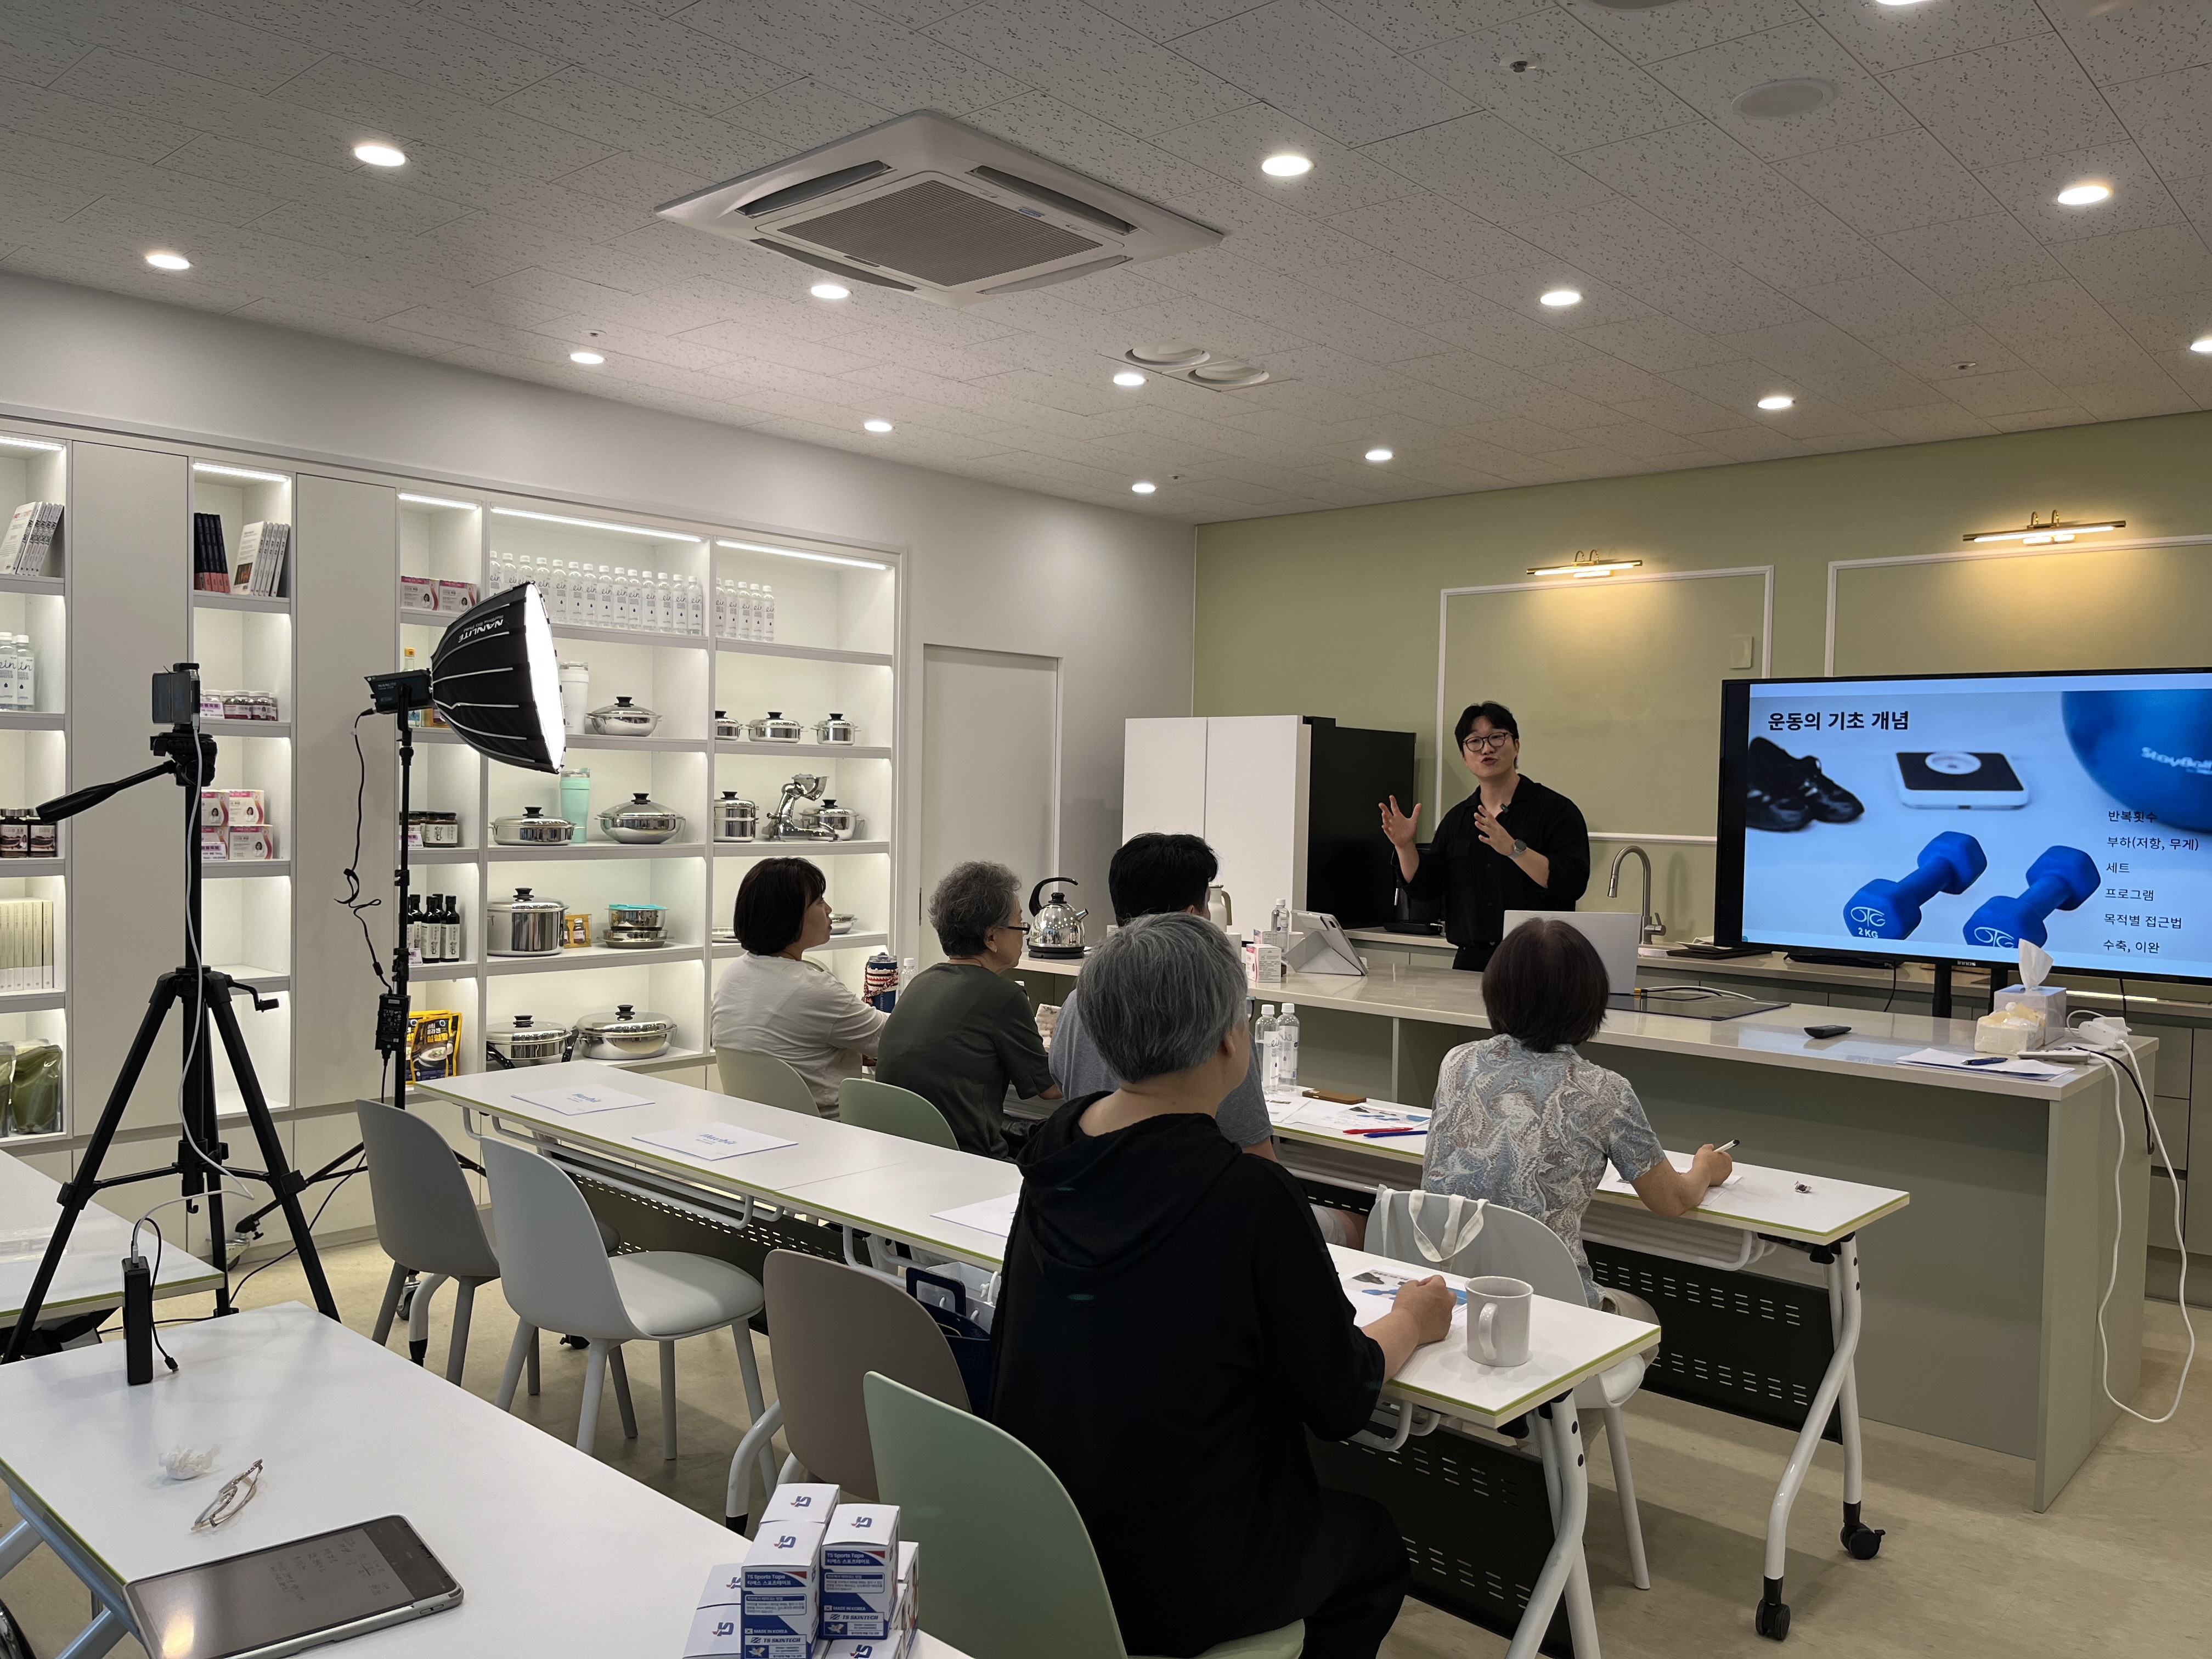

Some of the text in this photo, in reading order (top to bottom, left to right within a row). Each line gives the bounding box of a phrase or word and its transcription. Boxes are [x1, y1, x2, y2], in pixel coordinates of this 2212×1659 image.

[458, 619, 504, 644] NANLITE
[1768, 710, 1909, 731] 운동의 기초 개념
[2108, 810, 2158, 823] 반복횟수
[2107, 836, 2199, 851] 부하(저항, 무게)
[2106, 862, 2130, 874] 세트
[2104, 888, 2154, 901] 프로그램
[2103, 913, 2182, 929] 목적별 접근법
[2103, 939, 2160, 954] 수축, 이완
